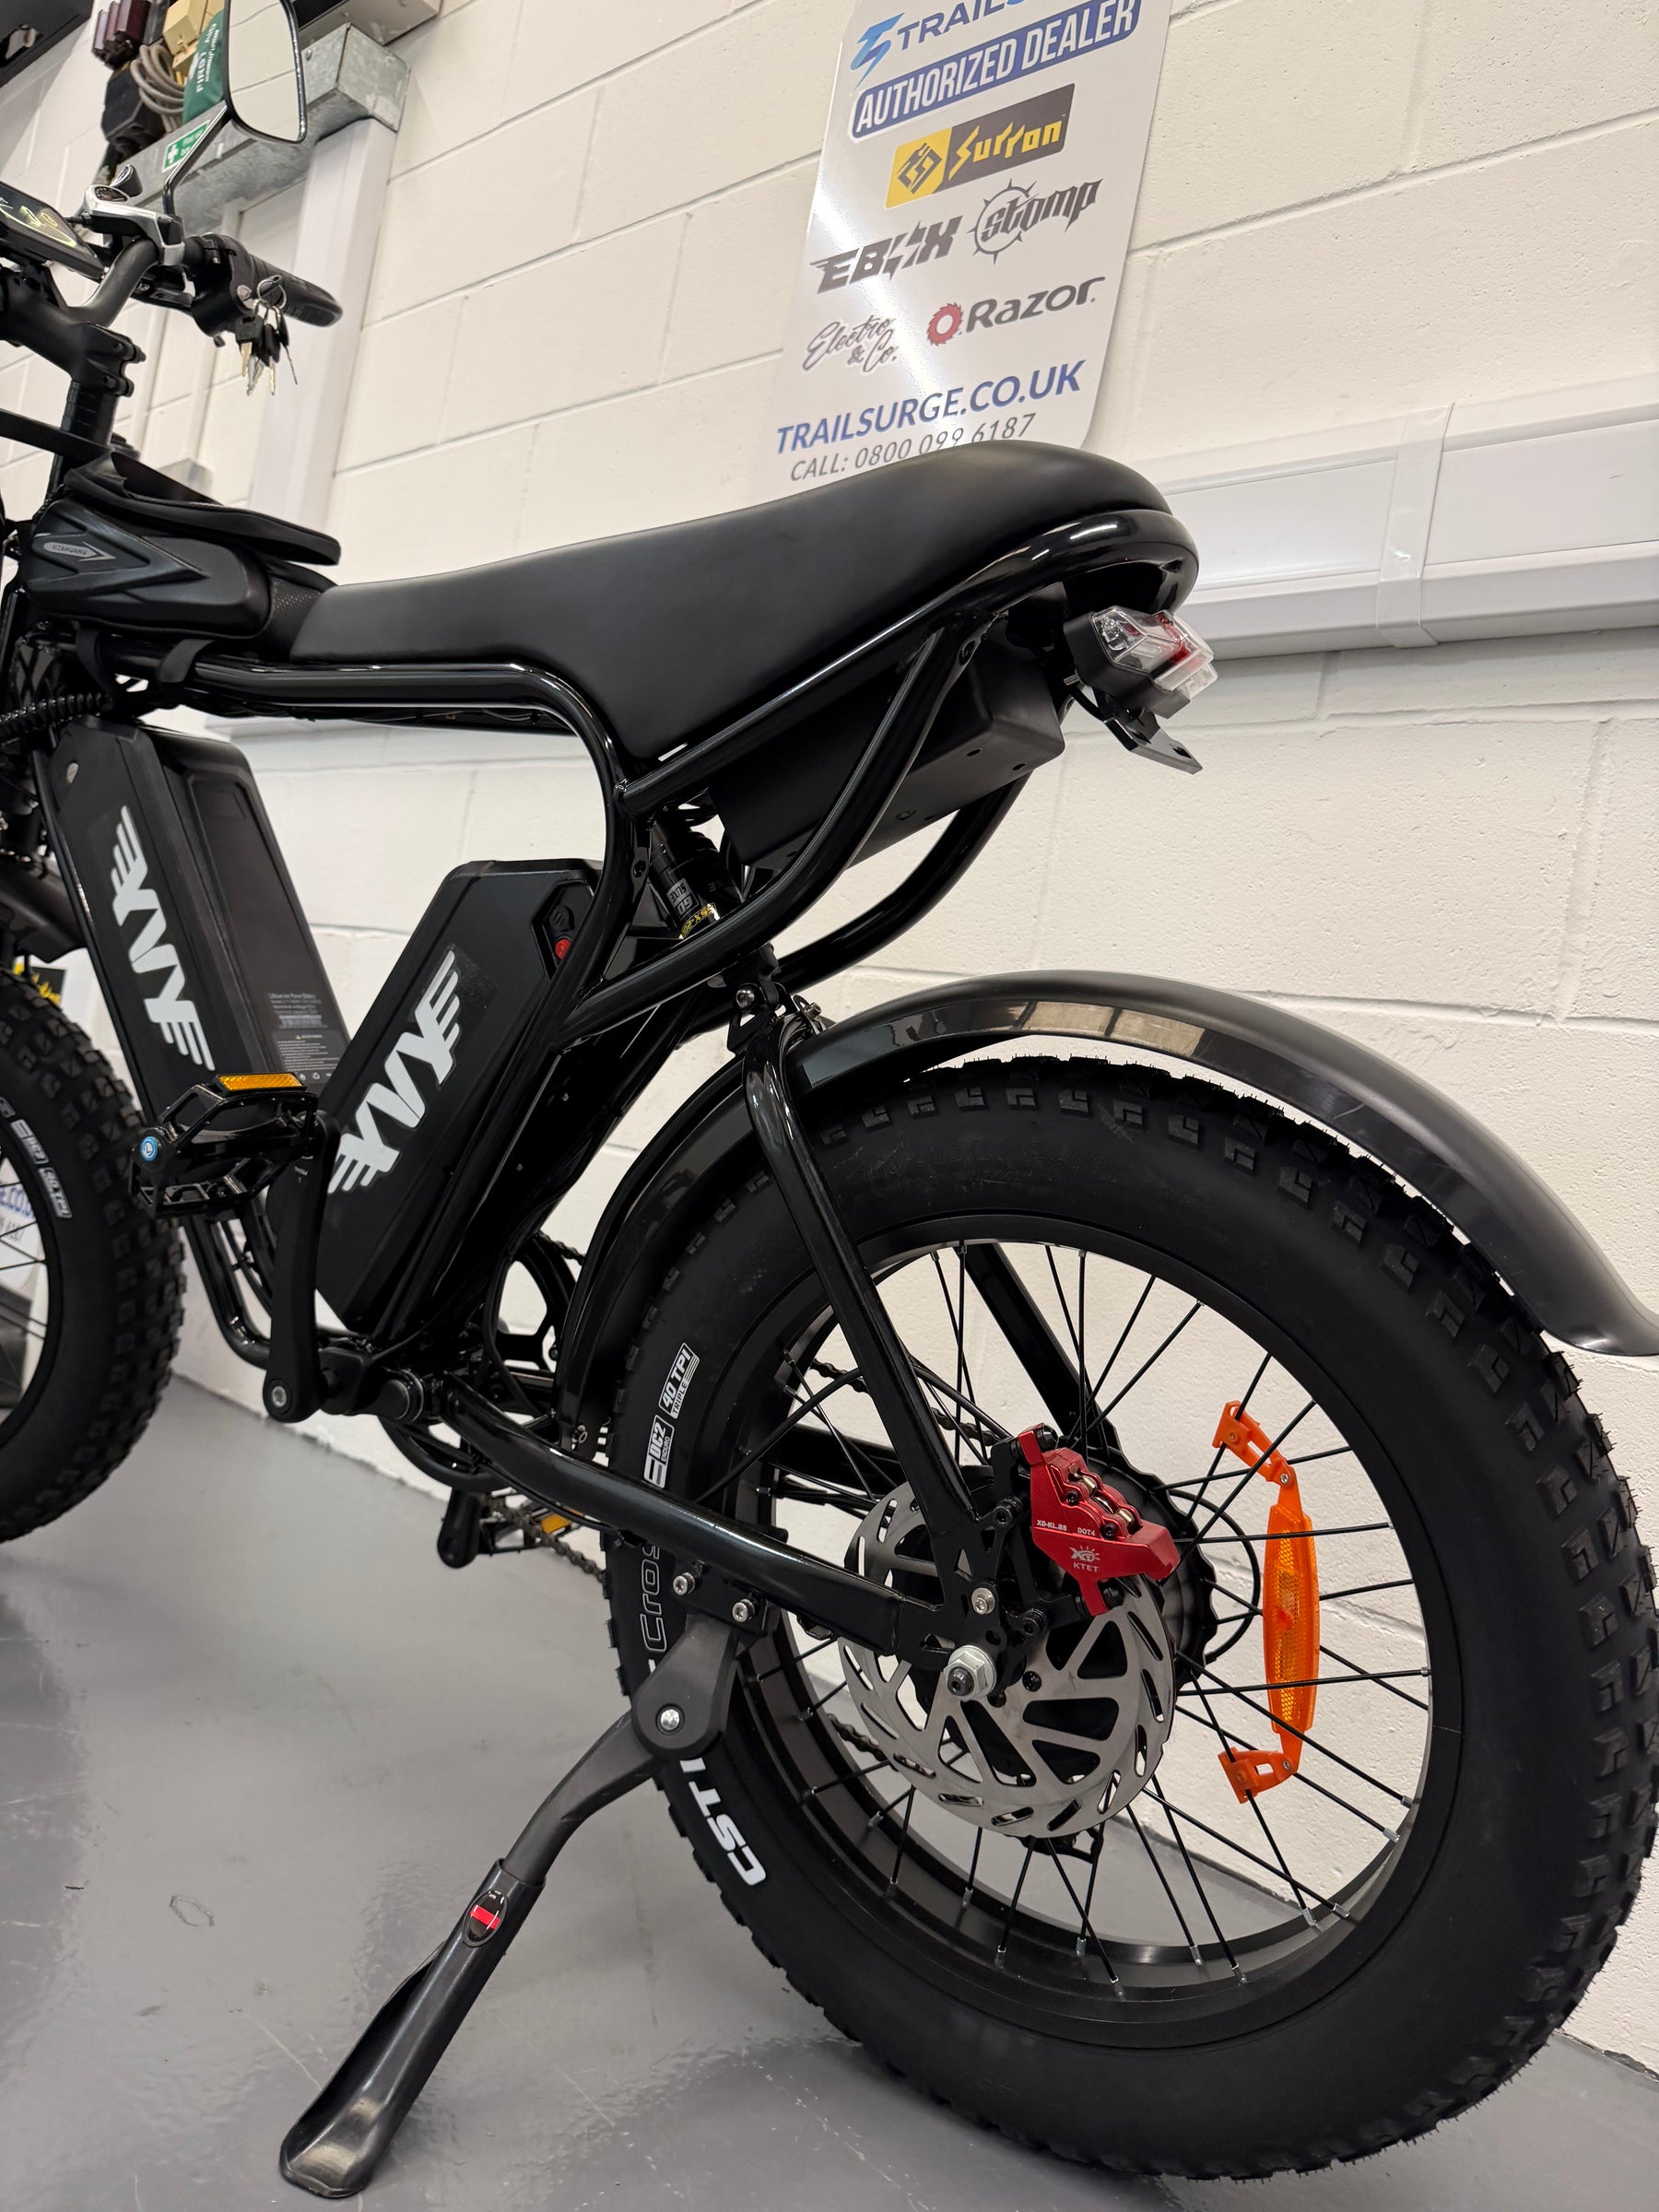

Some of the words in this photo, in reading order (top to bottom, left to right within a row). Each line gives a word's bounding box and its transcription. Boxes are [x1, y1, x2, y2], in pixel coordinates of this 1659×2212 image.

[195, 52, 207, 93] FIRST
[856, 38, 1018, 134] AUTHORIZED
[1021, 0, 1135, 71] DEALER
[777, 360, 1086, 455] TRAILSURGE.CO.UK
[791, 453, 849, 482] CALL:
[855, 439, 912, 469] 0800
[971, 412, 1037, 443] 6187
[663, 1382, 677, 1408] 40
[671, 1348, 691, 1382] TPI
[673, 1382, 688, 1414] TRIPLE
[649, 1421, 665, 1460] DC2
